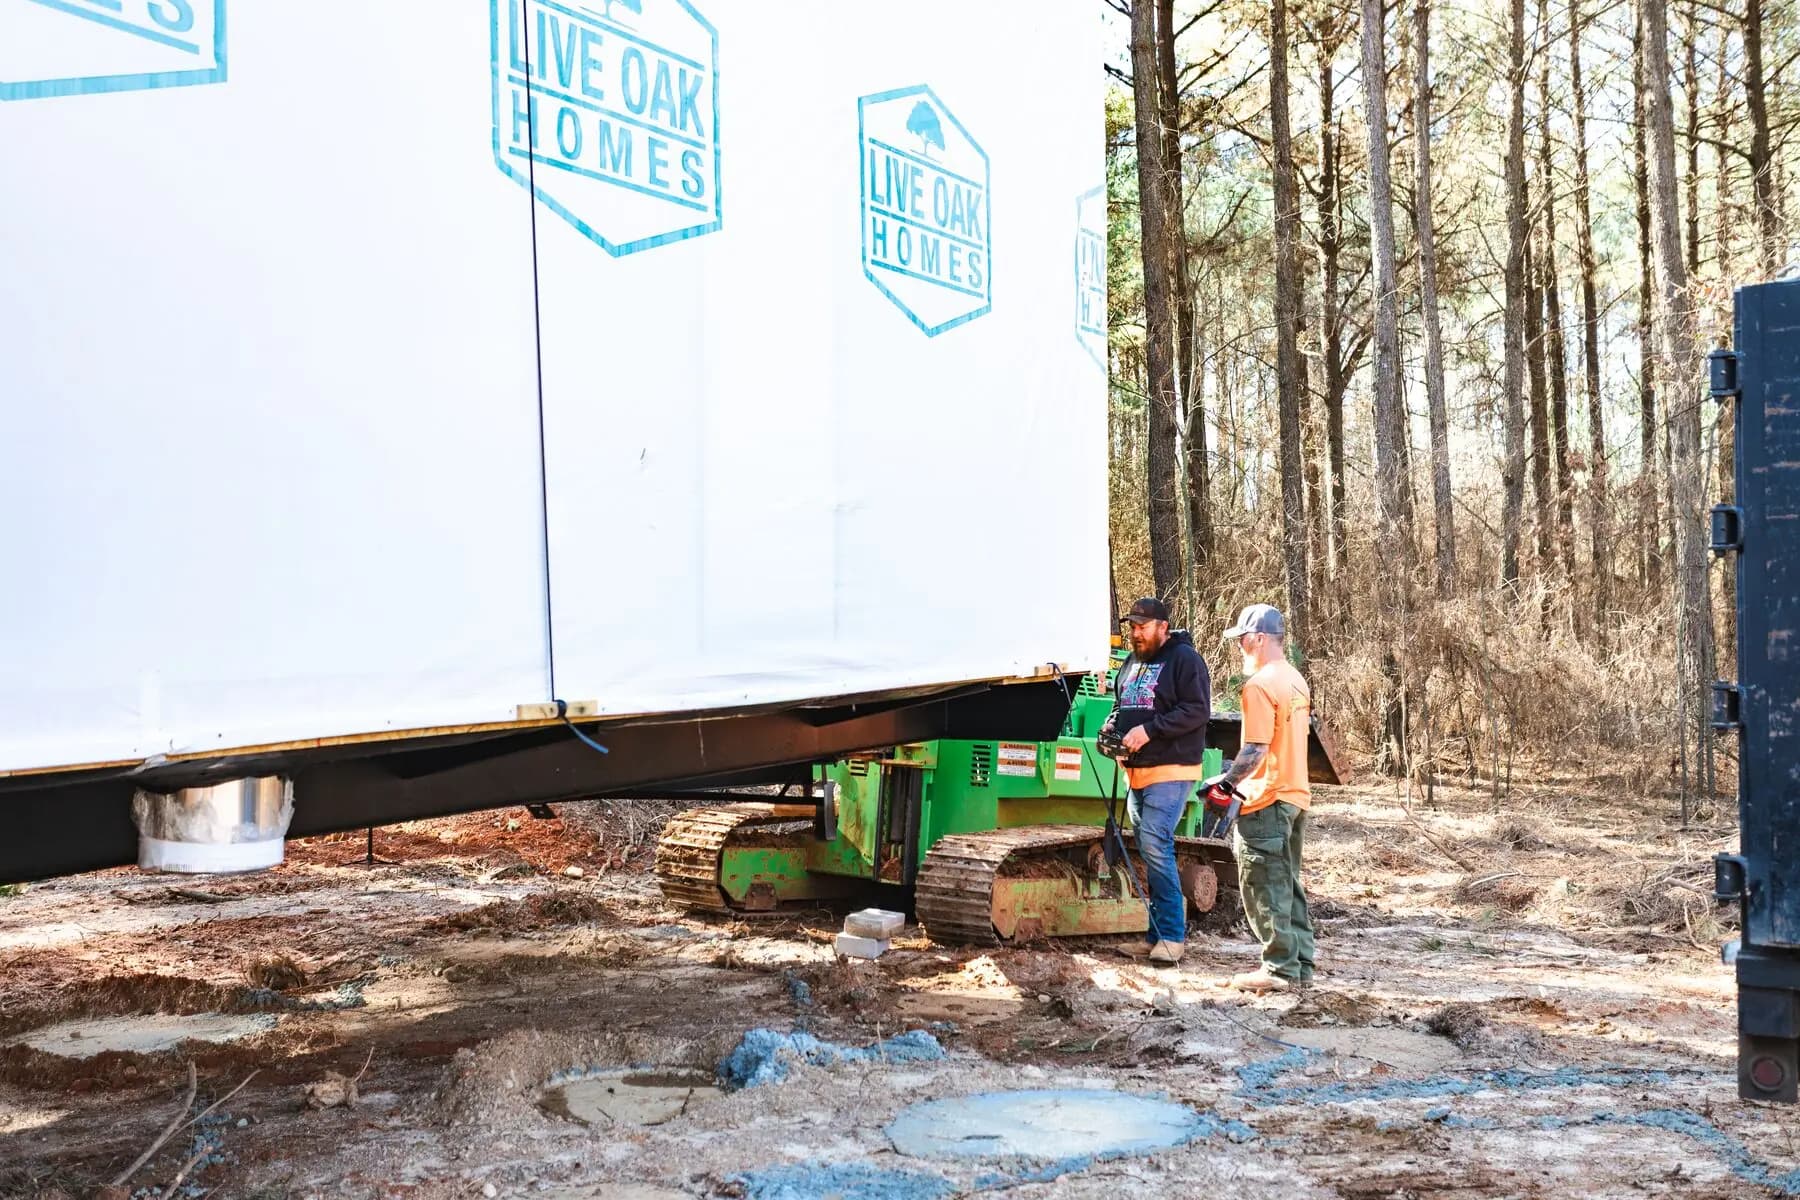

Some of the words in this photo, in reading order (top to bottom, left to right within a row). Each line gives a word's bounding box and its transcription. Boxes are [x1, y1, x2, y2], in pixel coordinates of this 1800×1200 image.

[508, 0, 604, 101] LIVE
[621, 46, 705, 137] OAK
[511, 89, 705, 198] HOMES
[870, 148, 924, 219] LIVE
[933, 175, 983, 240] OAK
[872, 216, 983, 289] HOMES
